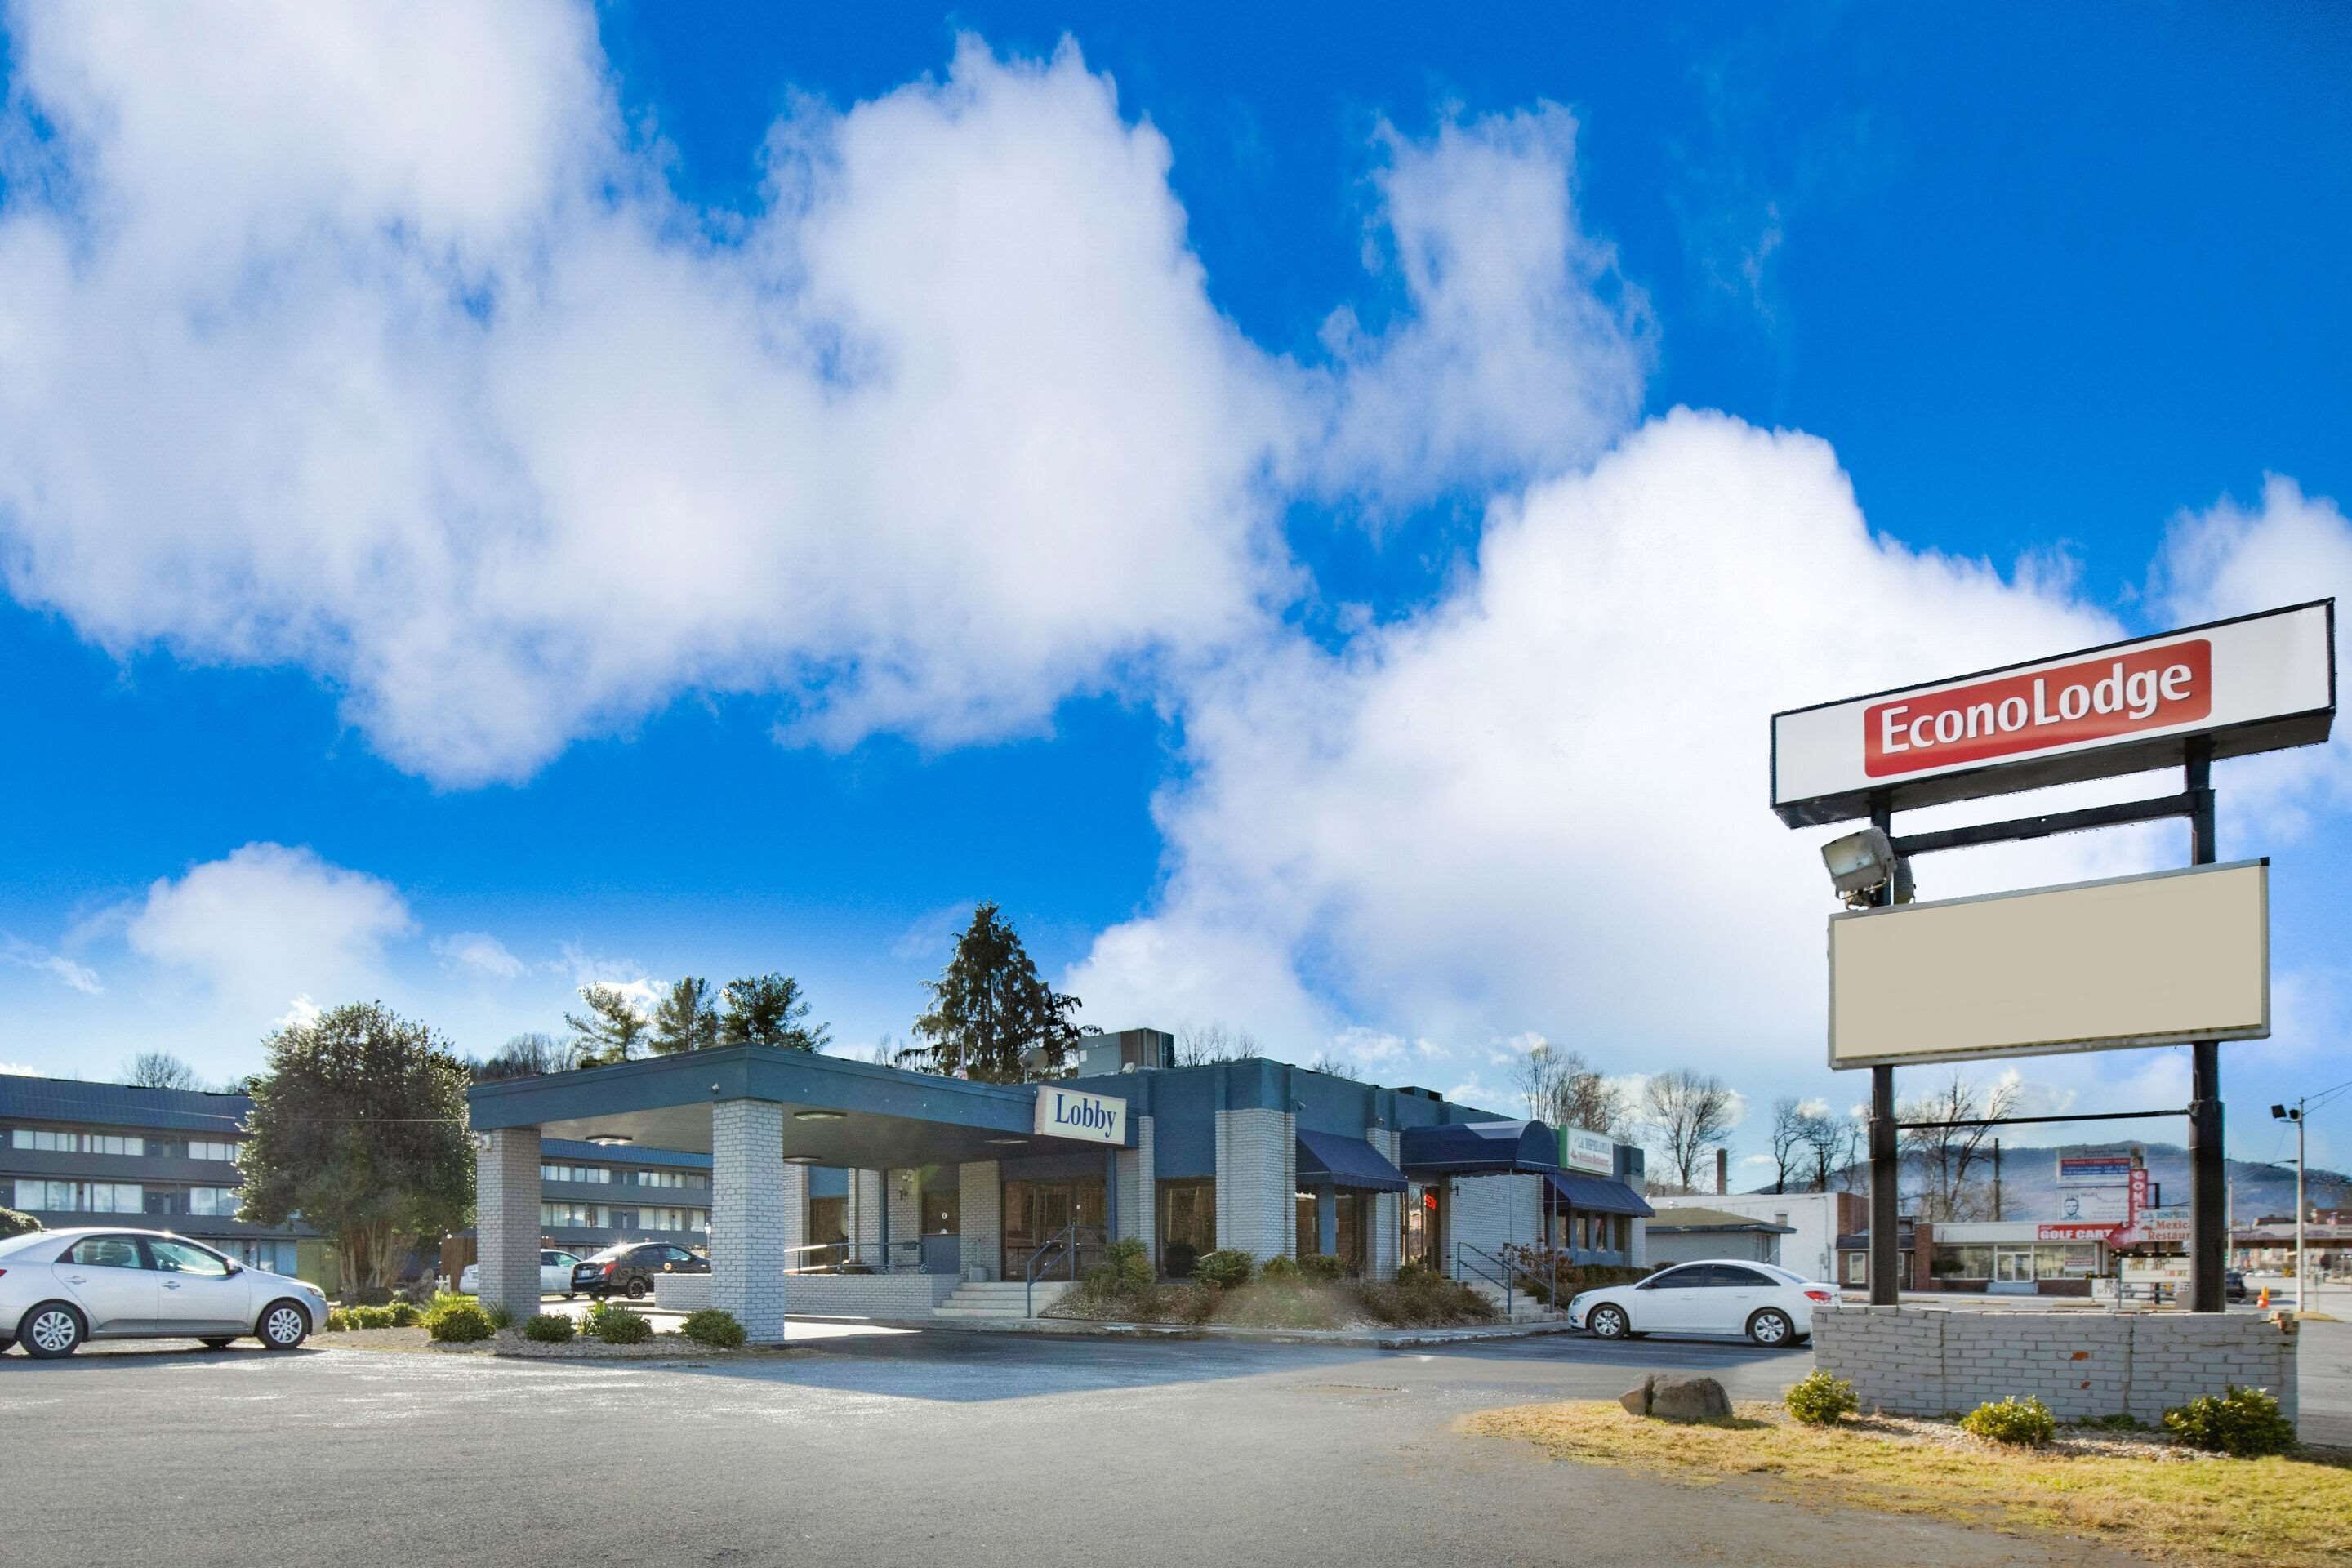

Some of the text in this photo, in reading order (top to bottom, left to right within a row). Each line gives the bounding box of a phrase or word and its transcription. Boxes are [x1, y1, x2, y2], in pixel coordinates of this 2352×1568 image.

[1881, 662, 2193, 755] EconoLodge
[1054, 1093, 1117, 1138] Lobby
[2156, 1220, 2190, 1230] Mexic
[2040, 1229, 2074, 1240] GOLF
[2148, 1231, 2190, 1241] Restaur
